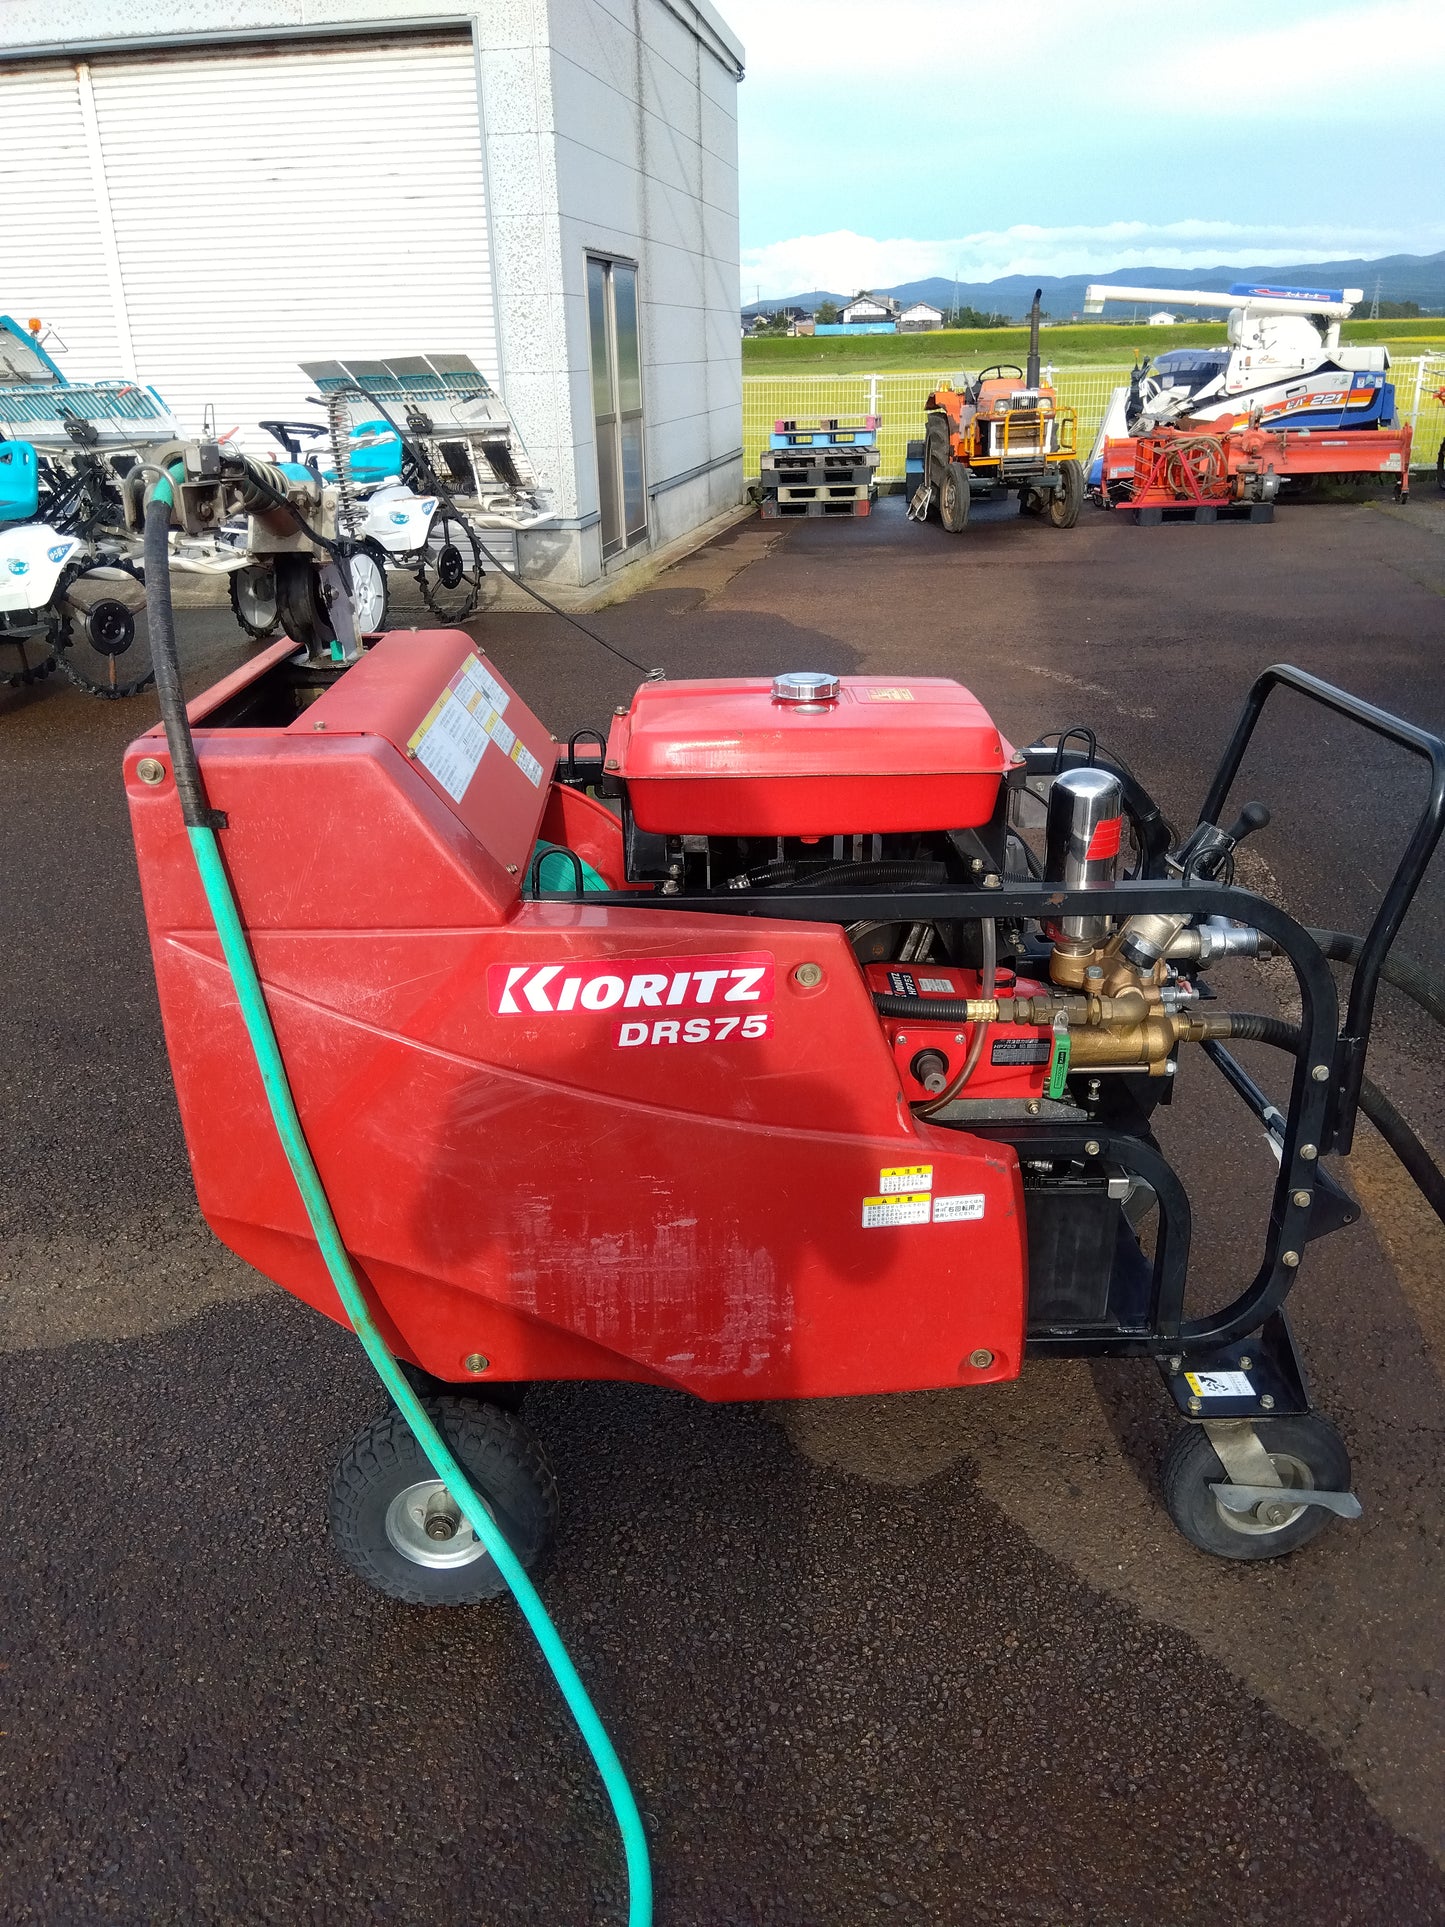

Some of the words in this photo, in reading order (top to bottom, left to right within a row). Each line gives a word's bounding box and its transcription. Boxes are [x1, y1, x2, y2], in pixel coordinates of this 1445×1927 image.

[1310, 393, 1344, 406] 221
[498, 965, 766, 1013] KIORITZ
[618, 1014, 769, 1047] DRS75
